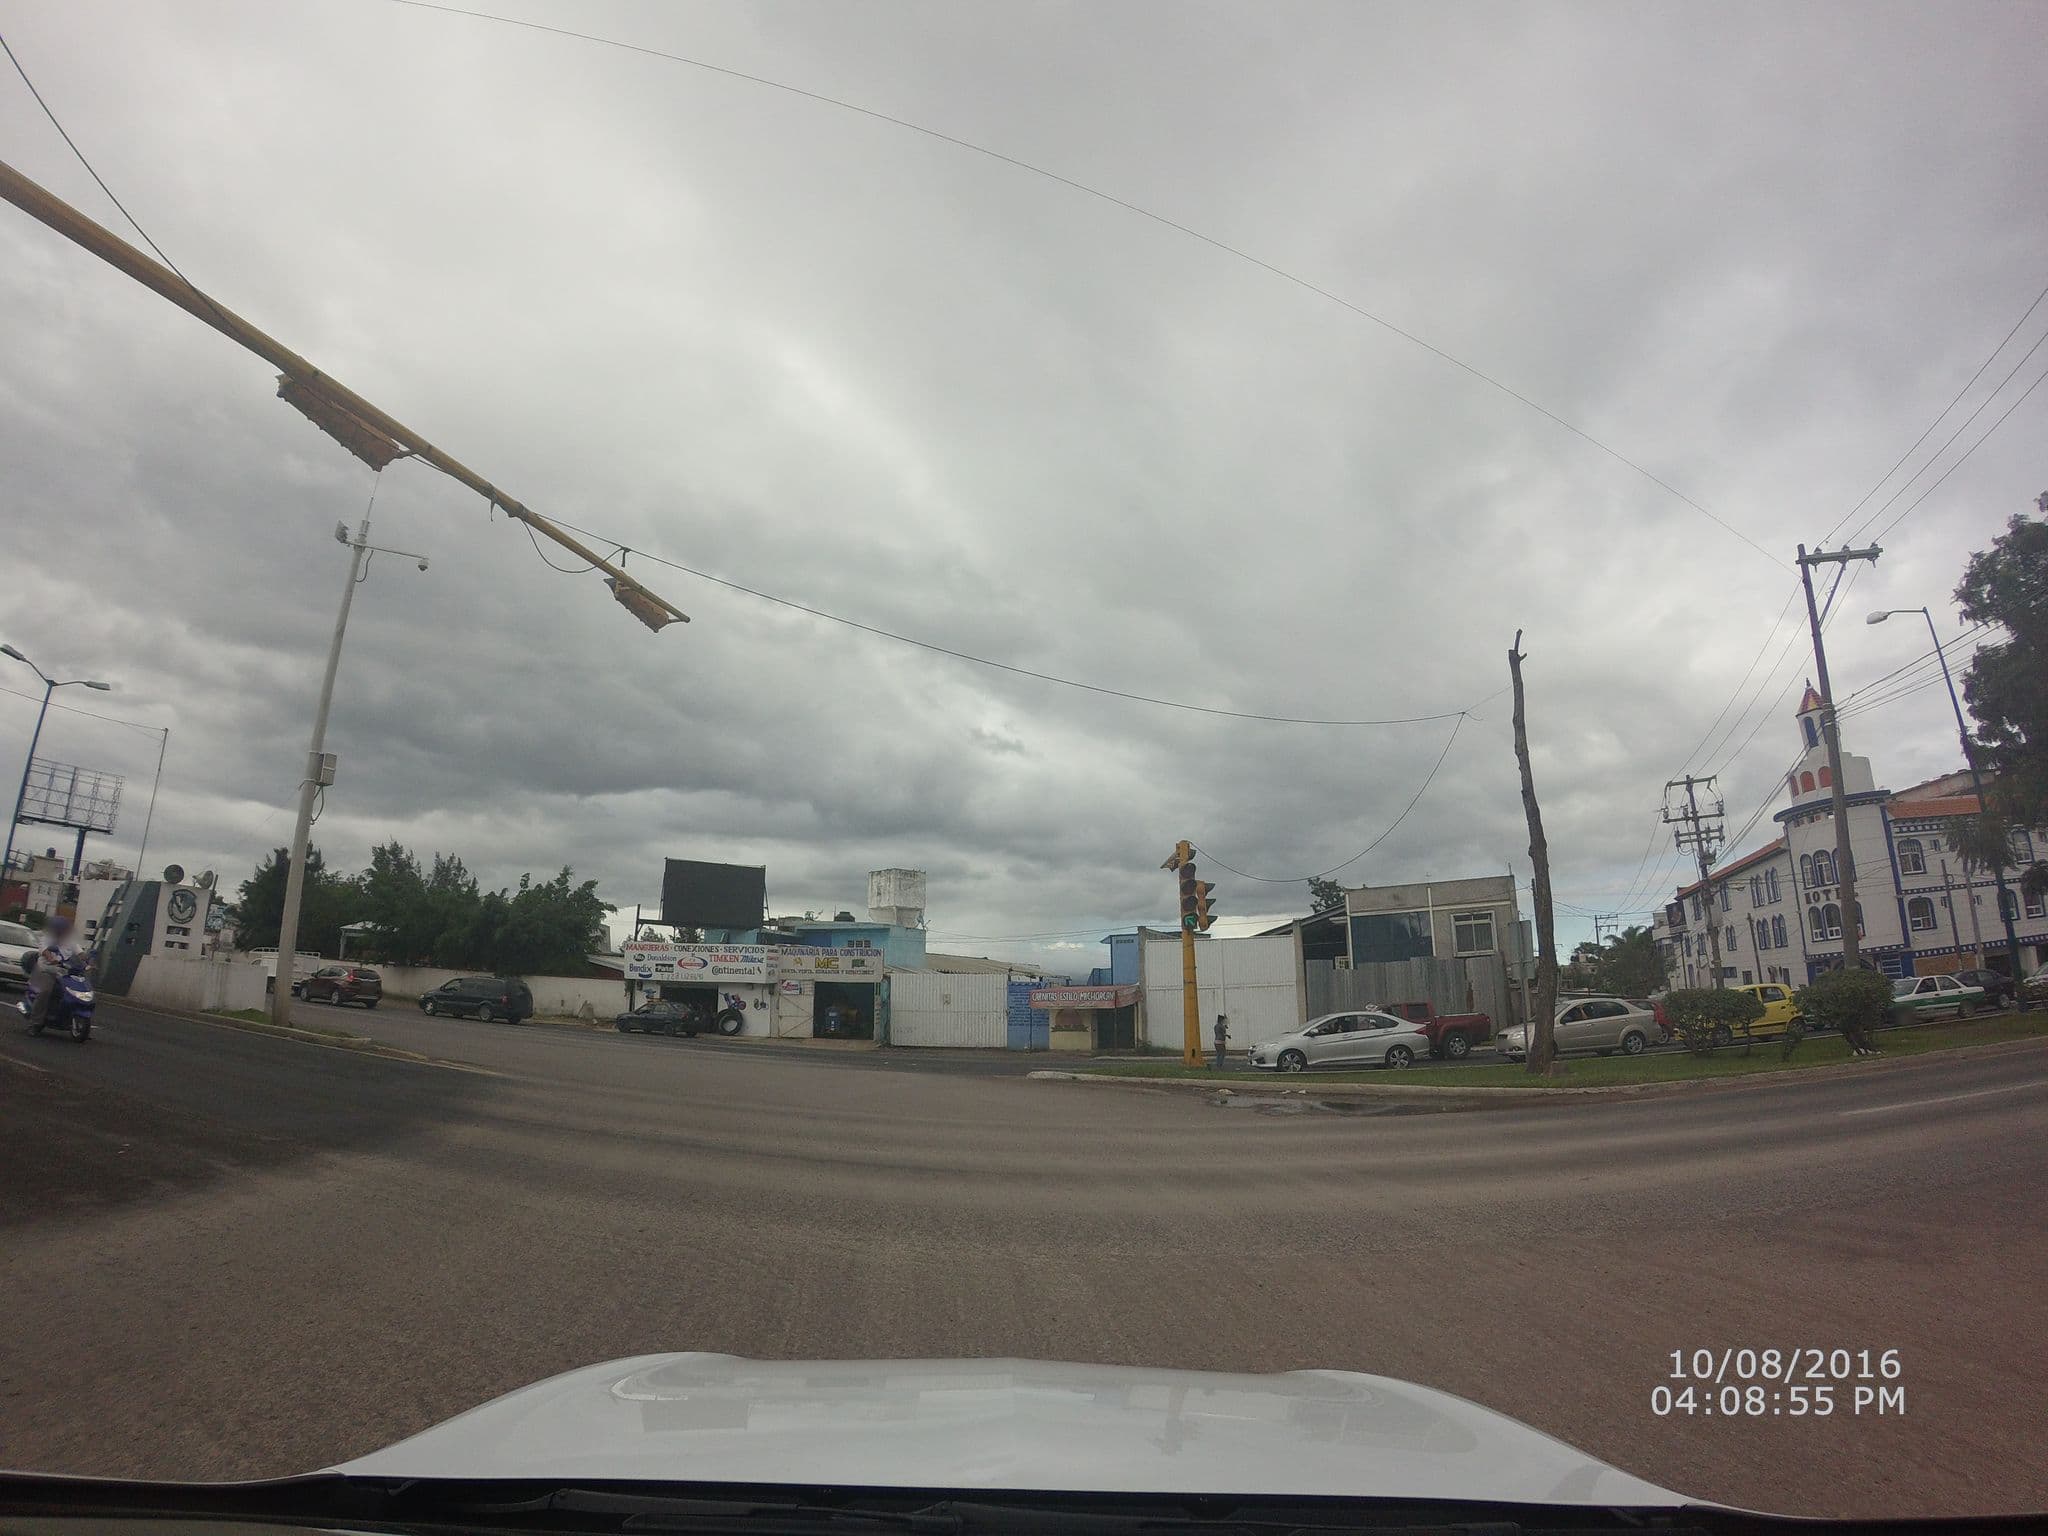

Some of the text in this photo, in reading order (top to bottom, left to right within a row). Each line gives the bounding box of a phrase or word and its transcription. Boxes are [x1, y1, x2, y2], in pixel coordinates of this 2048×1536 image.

[673, 944, 719, 953] CONEXIONES
[723, 945, 765, 954] SERVICIOS
[781, 948, 820, 957] MAQUINARIA
[821, 948, 838, 957] PARA
[647, 953, 677, 962] Donaldson
[709, 954, 740, 962] TIMKEN
[629, 963, 652, 972] Bendix
[1059, 991, 1078, 1002] ESTILO
